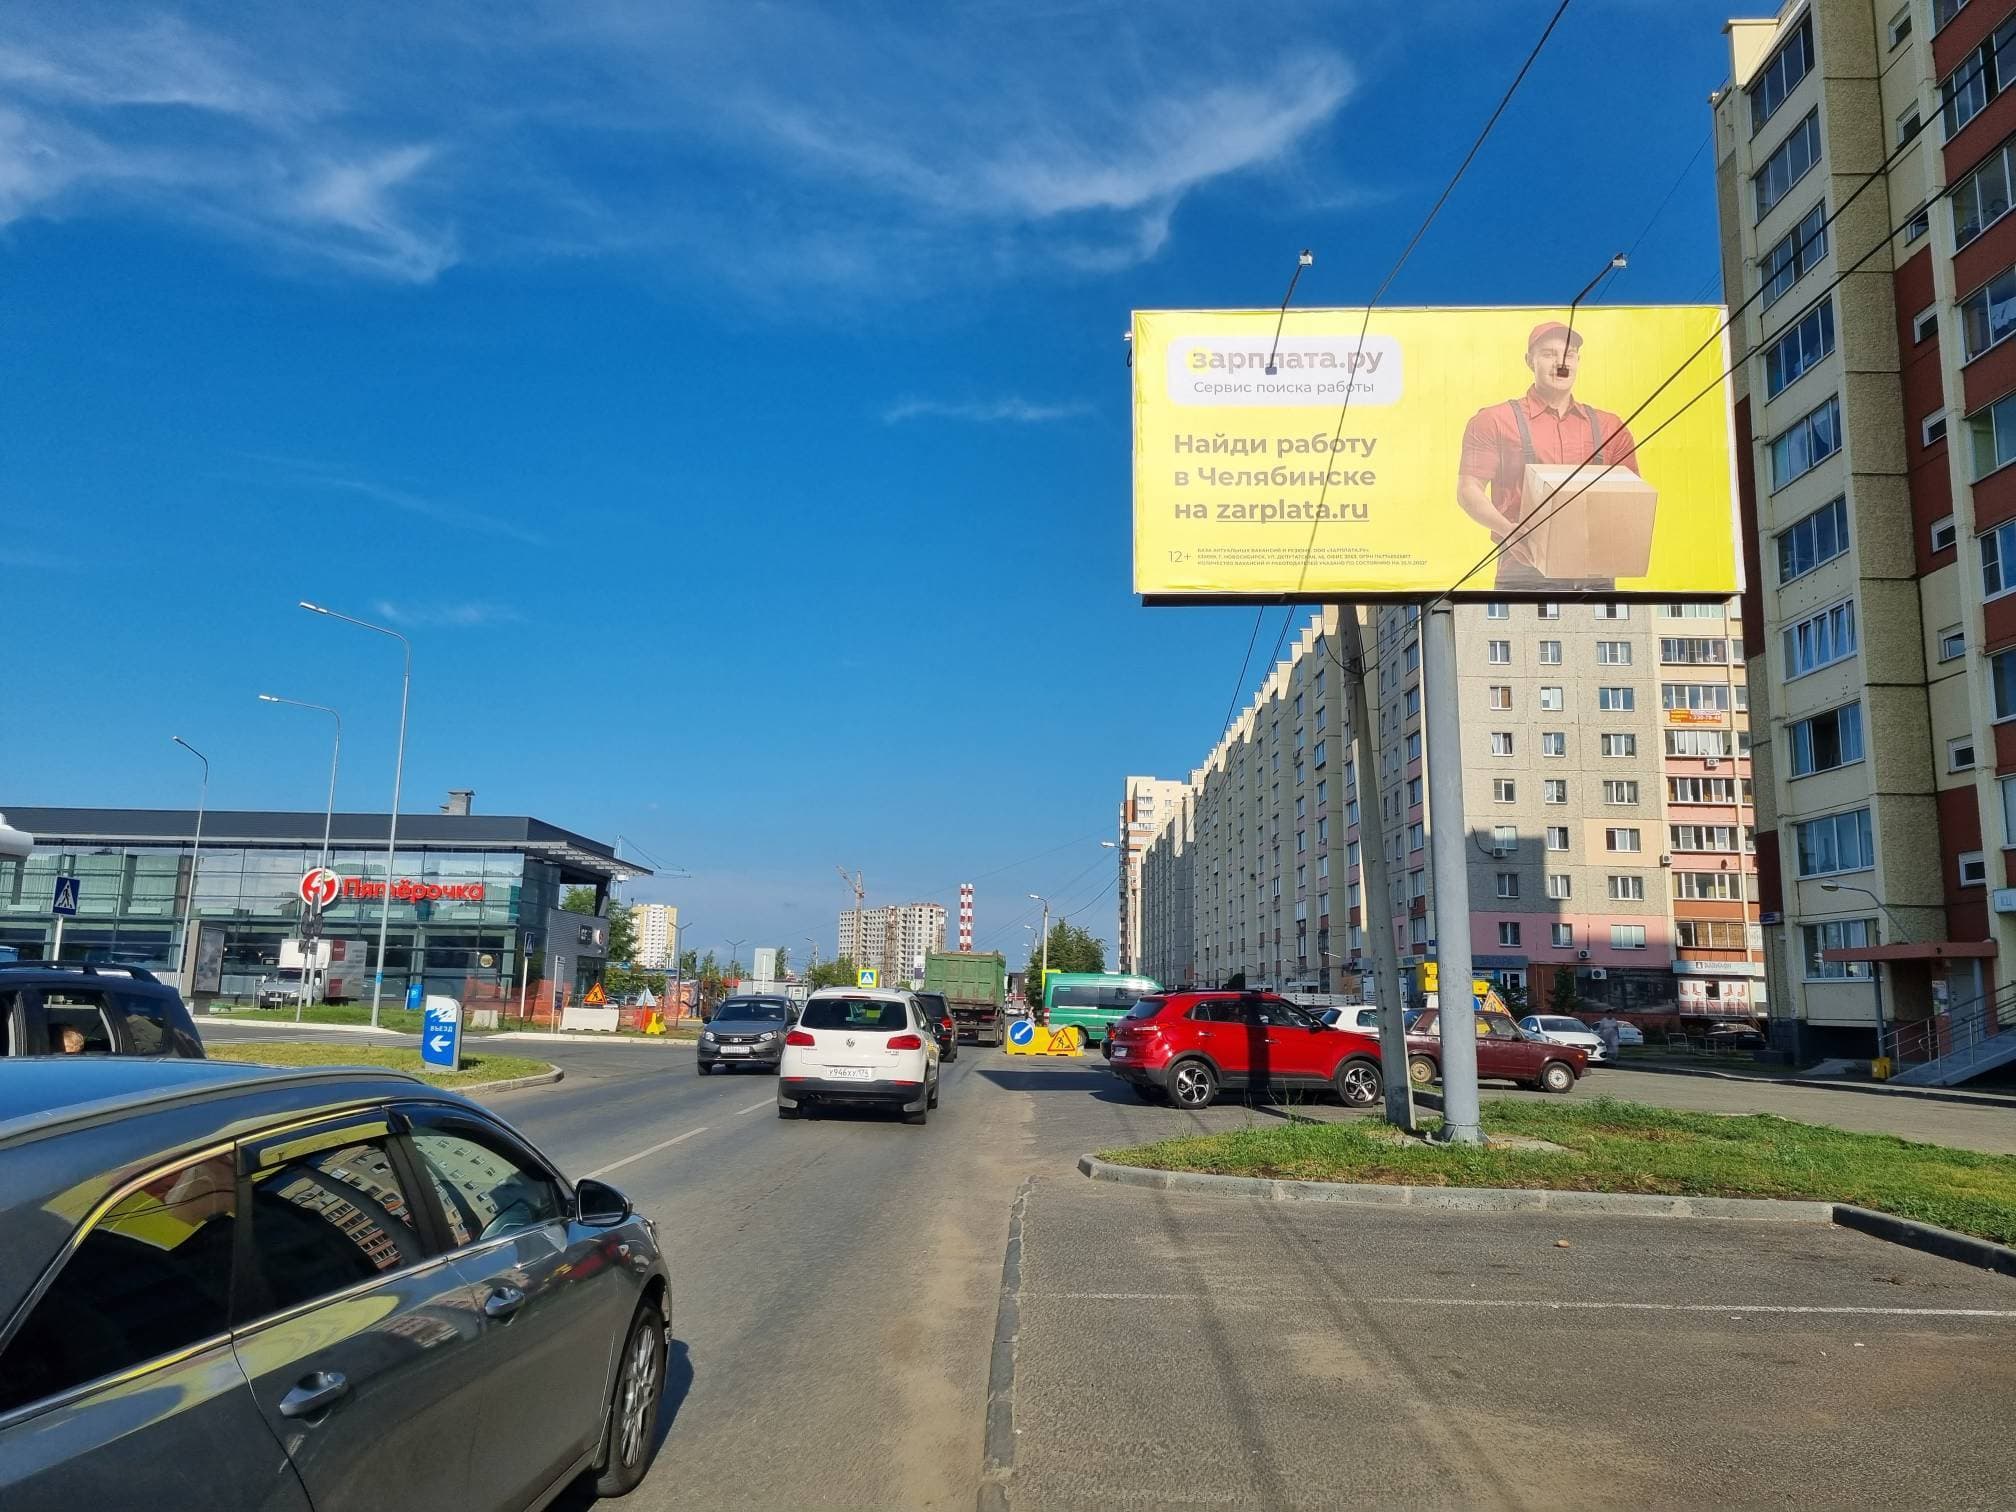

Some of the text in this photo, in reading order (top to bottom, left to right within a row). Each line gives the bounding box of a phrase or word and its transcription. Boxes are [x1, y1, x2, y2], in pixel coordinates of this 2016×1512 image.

[1192, 351, 1384, 374] зарплата.ру
[1193, 381, 1374, 395] Сервис поиска работы
[1174, 432, 1377, 458] Найди работу
[1174, 466, 1377, 486] в Челябинске
[1175, 499, 1369, 523] на zarplata.ru
[1168, 550, 1192, 563] 12+
[343, 877, 485, 902] Пятёрочка
[430, 1025, 453, 1033] ВЪЕЗД
